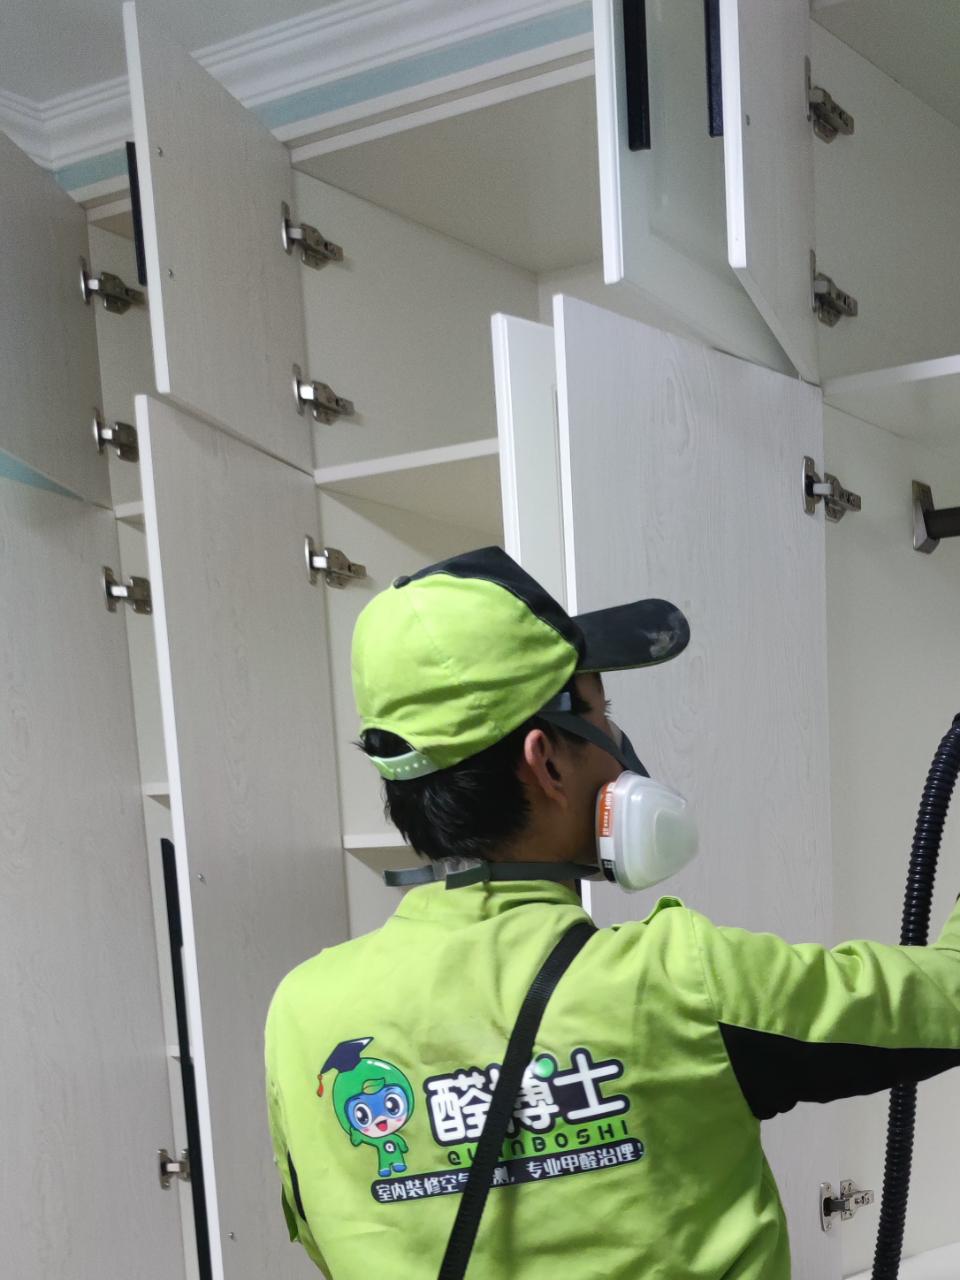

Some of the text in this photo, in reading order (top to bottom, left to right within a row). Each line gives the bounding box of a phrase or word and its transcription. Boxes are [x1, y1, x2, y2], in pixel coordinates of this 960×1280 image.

[426, 1050, 627, 1143] 醛博士
[447, 1119, 629, 1166] QNBOSHI
